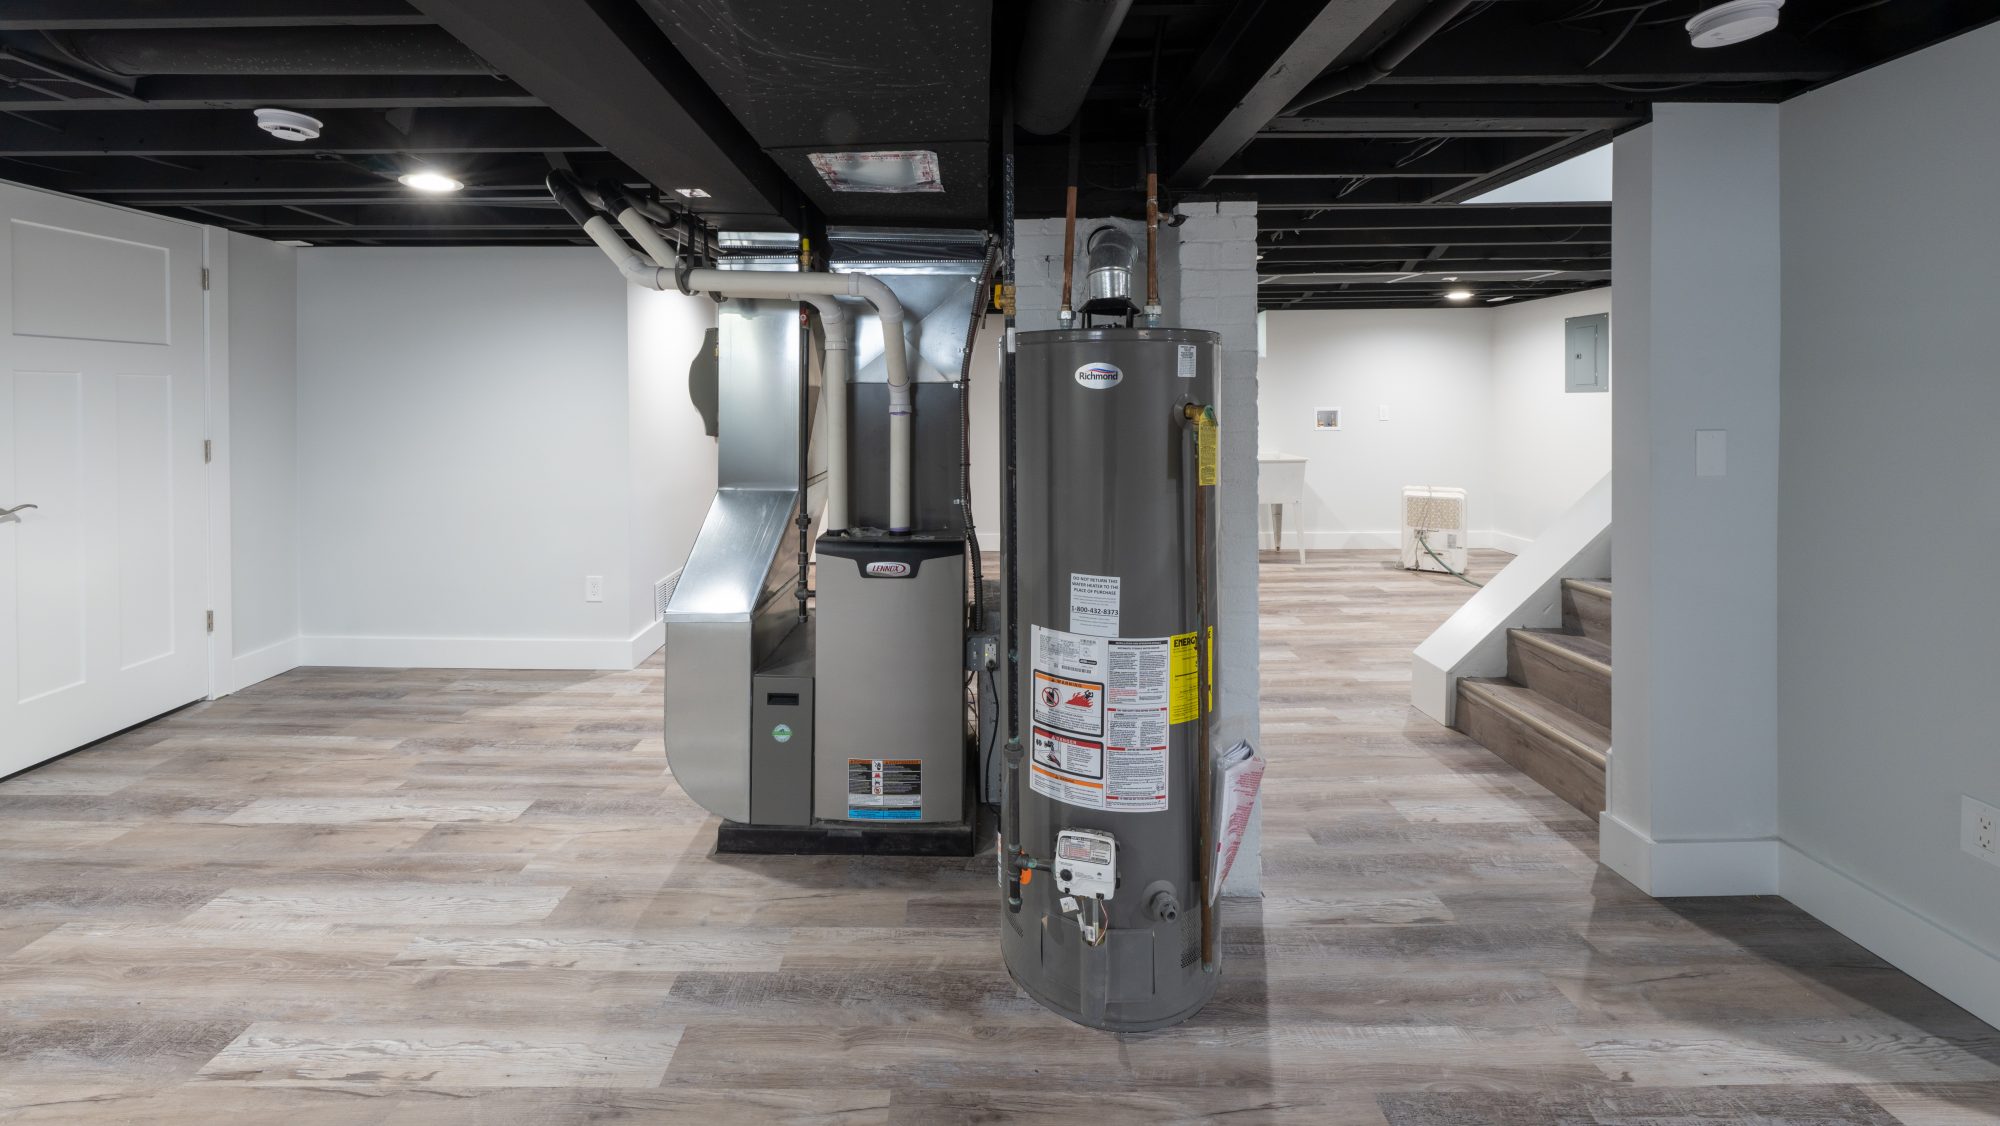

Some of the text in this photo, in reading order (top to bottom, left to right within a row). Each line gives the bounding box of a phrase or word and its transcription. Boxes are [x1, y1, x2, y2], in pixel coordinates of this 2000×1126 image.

[1079, 371, 1118, 380] Richmond
[872, 564, 901, 572] LENNOX
[1072, 606, 1119, 616] 1-800-432-8373
